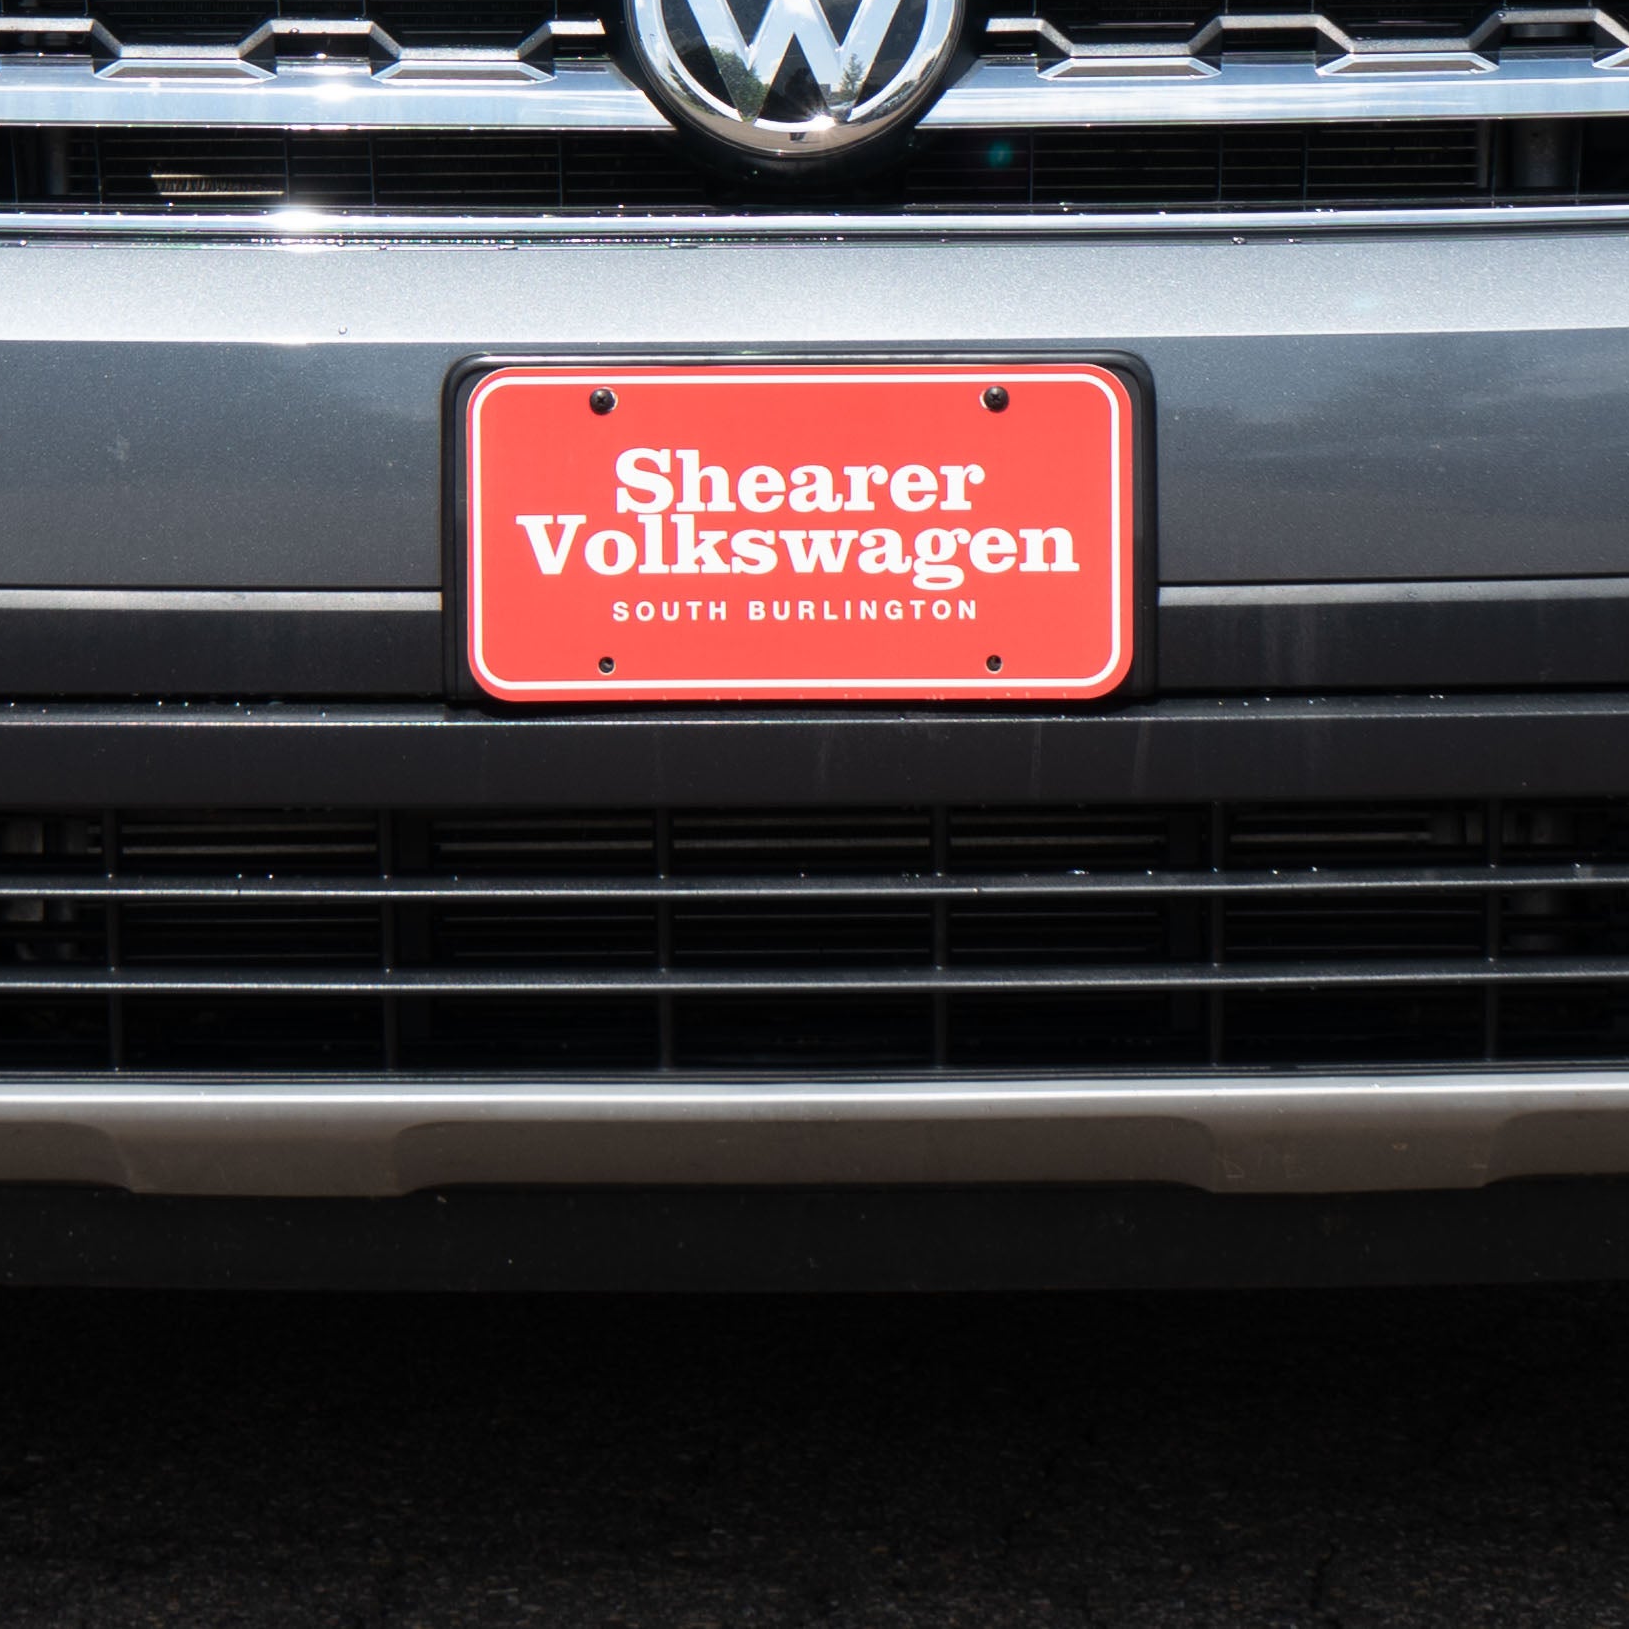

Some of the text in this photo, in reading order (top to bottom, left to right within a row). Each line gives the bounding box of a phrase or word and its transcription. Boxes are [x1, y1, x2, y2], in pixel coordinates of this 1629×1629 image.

[615, 448, 985, 514] Shearer
[516, 514, 1080, 591] Volkswagen
[612, 599, 977, 622] SOUTH BURLINGTON
